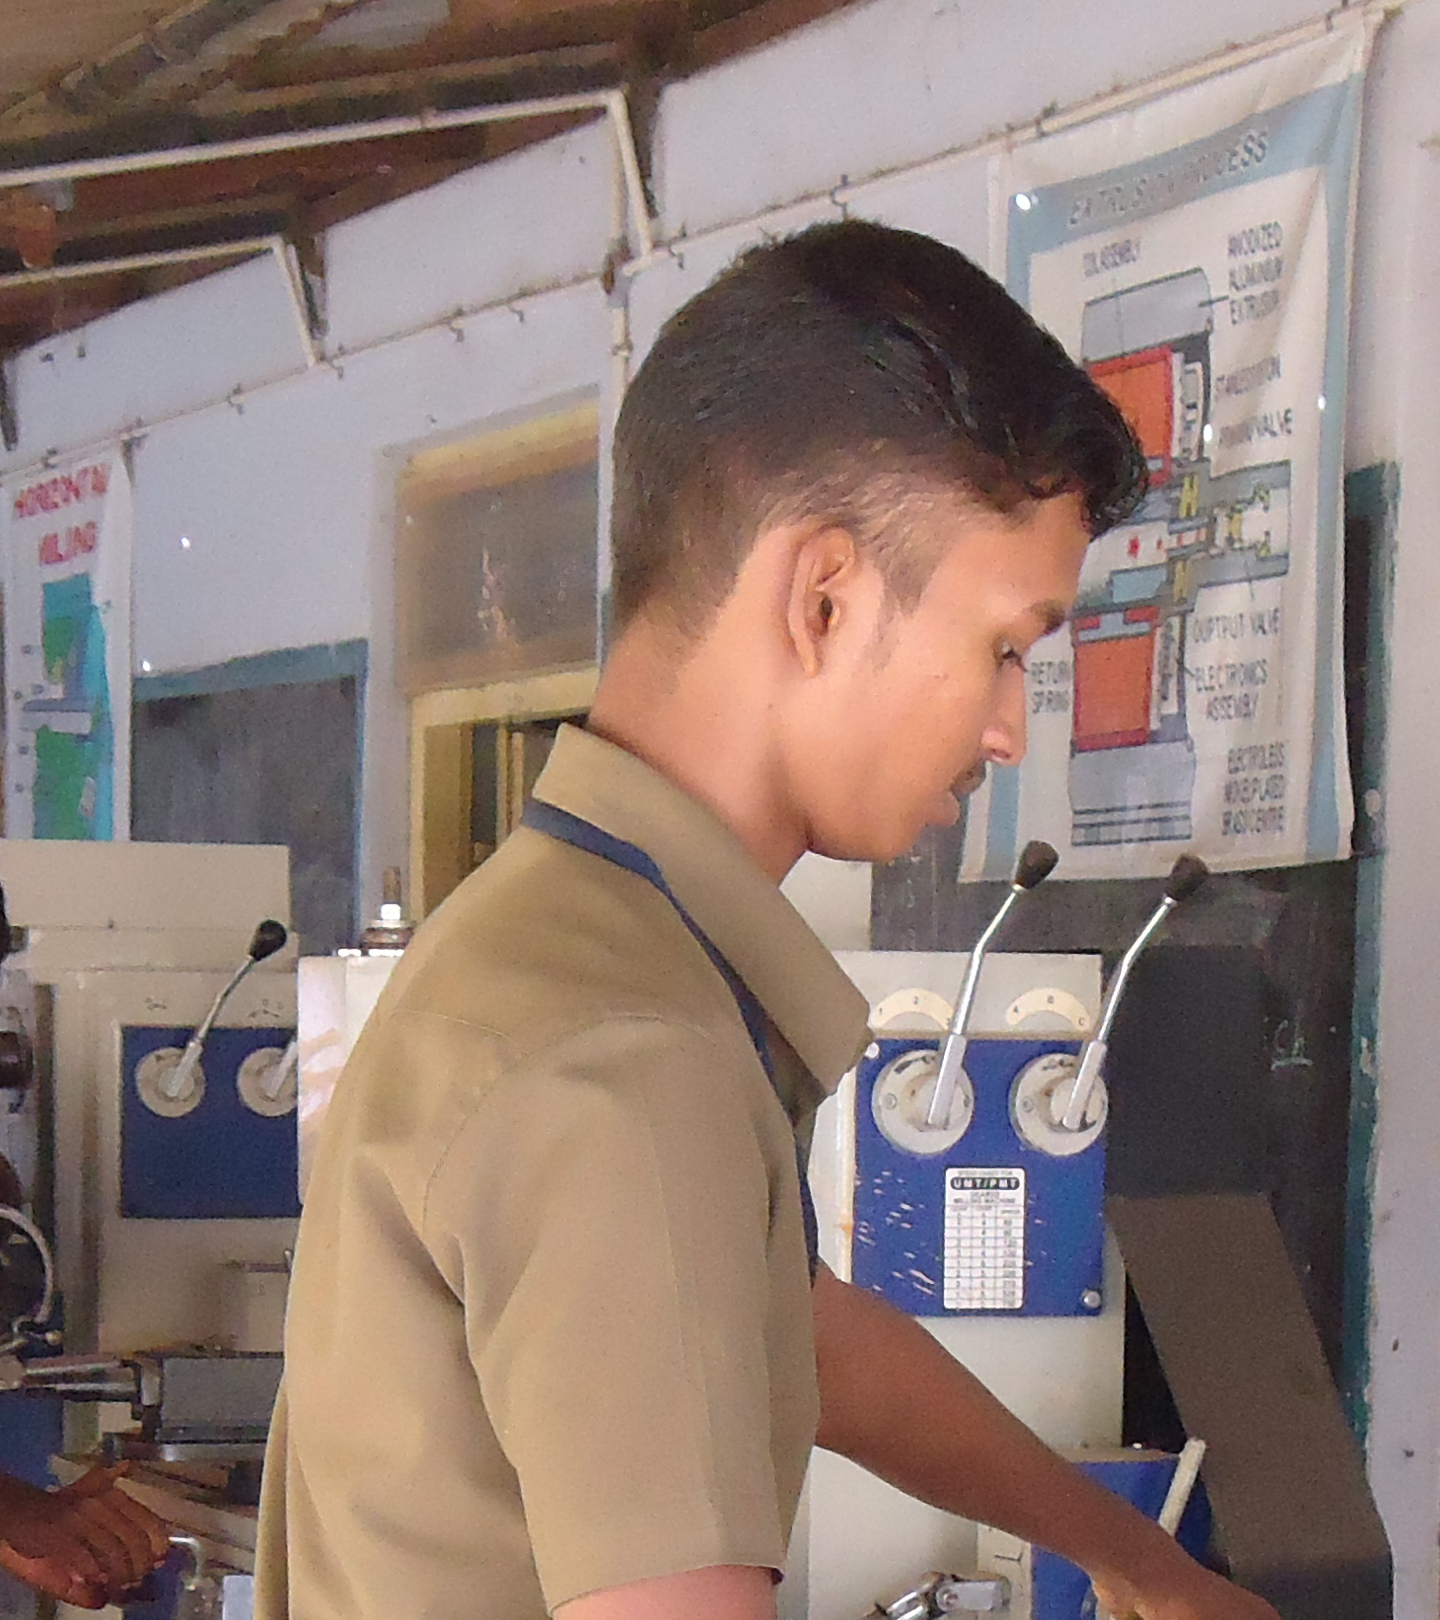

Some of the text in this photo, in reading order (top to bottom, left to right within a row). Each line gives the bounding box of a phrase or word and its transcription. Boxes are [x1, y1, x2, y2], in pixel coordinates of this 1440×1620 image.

[1181, 130, 1269, 185] PROCESS
[913, 996, 920, 1006] 2
[952, 1178, 1018, 1189] UMT/PMT
